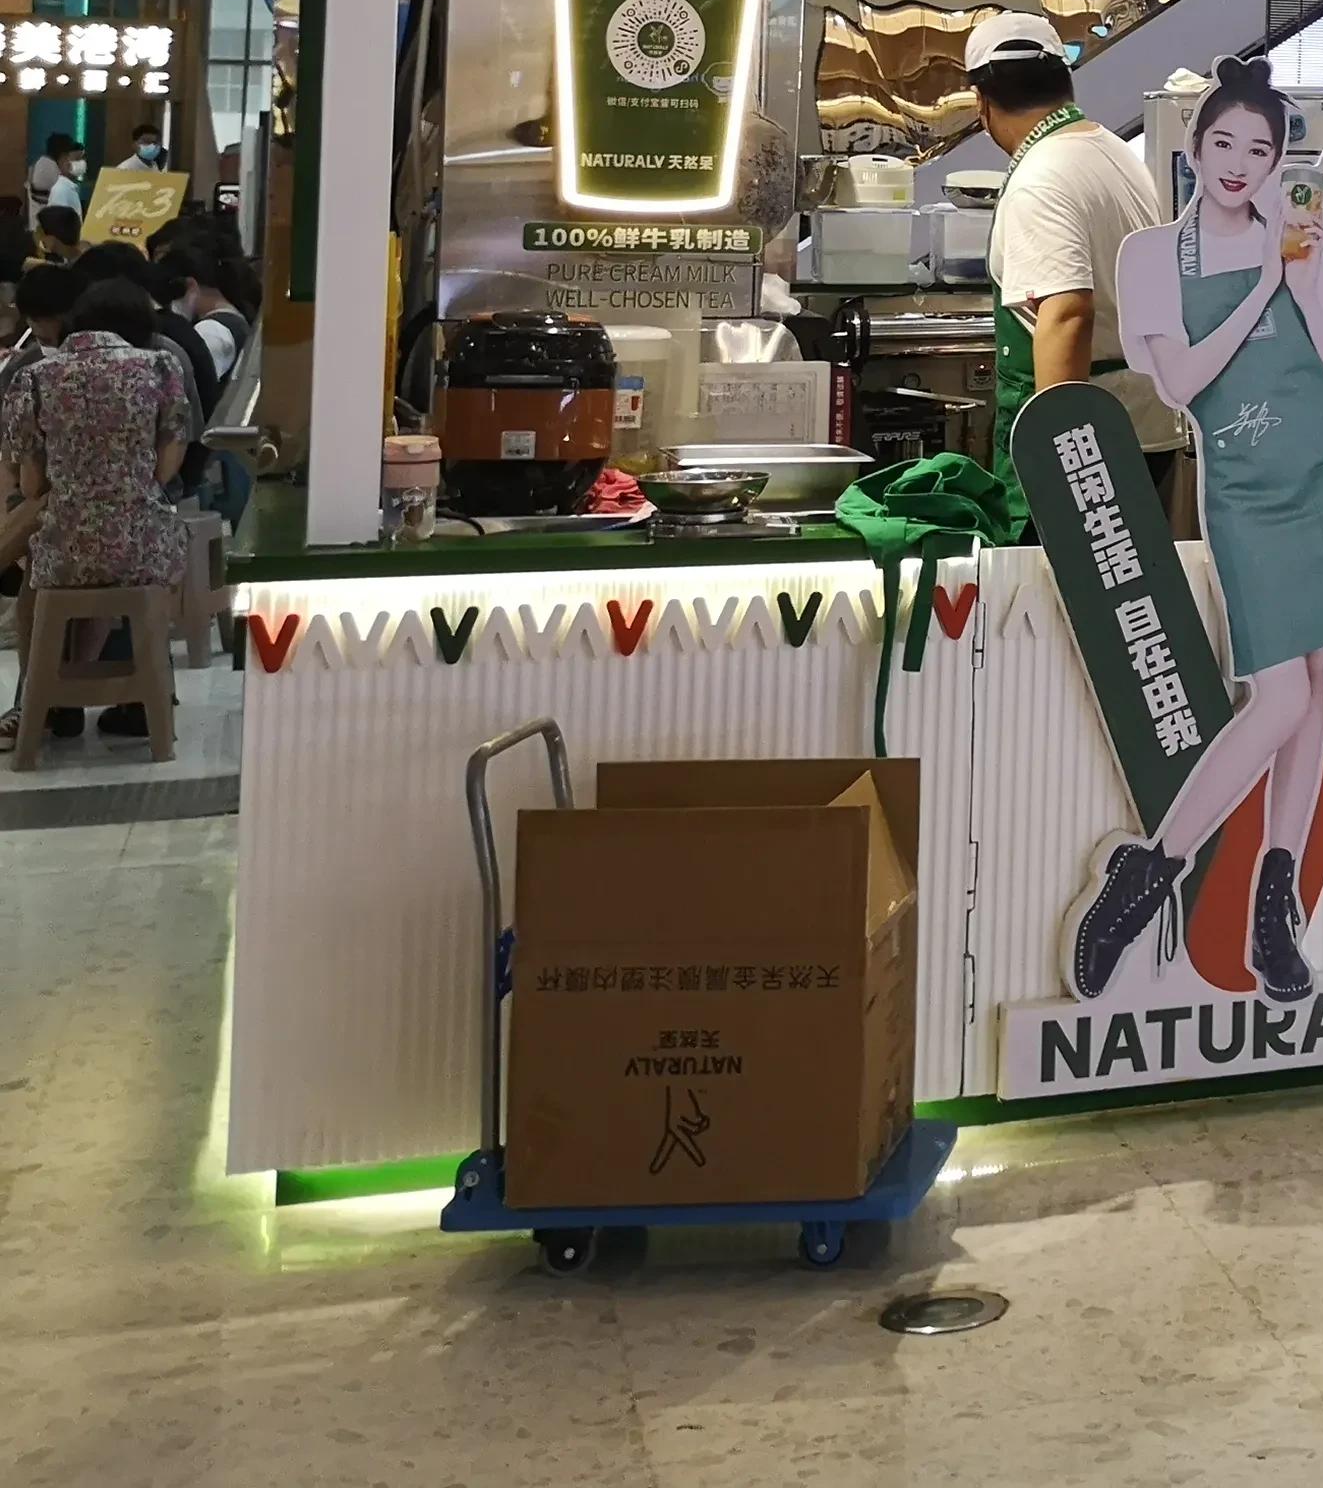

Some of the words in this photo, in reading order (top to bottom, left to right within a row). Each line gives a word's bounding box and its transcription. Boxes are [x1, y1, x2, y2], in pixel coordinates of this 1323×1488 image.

[581, 153, 665, 169] NATURALV
[667, 155, 714, 171] 天然呆
[533, 226, 750, 252] 100%鲜牛乳制造
[547, 263, 604, 282] PURE
[609, 264, 680, 283] CREAM
[687, 265, 737, 283] MILK
[546, 290, 690, 310] WELL-CHOSEN
[697, 292, 735, 310] TEA
[1053, 423, 1144, 591] 甜闲生活
[1115, 594, 1202, 758] 自在由我
[624, 1056, 743, 1077] NATURALV
